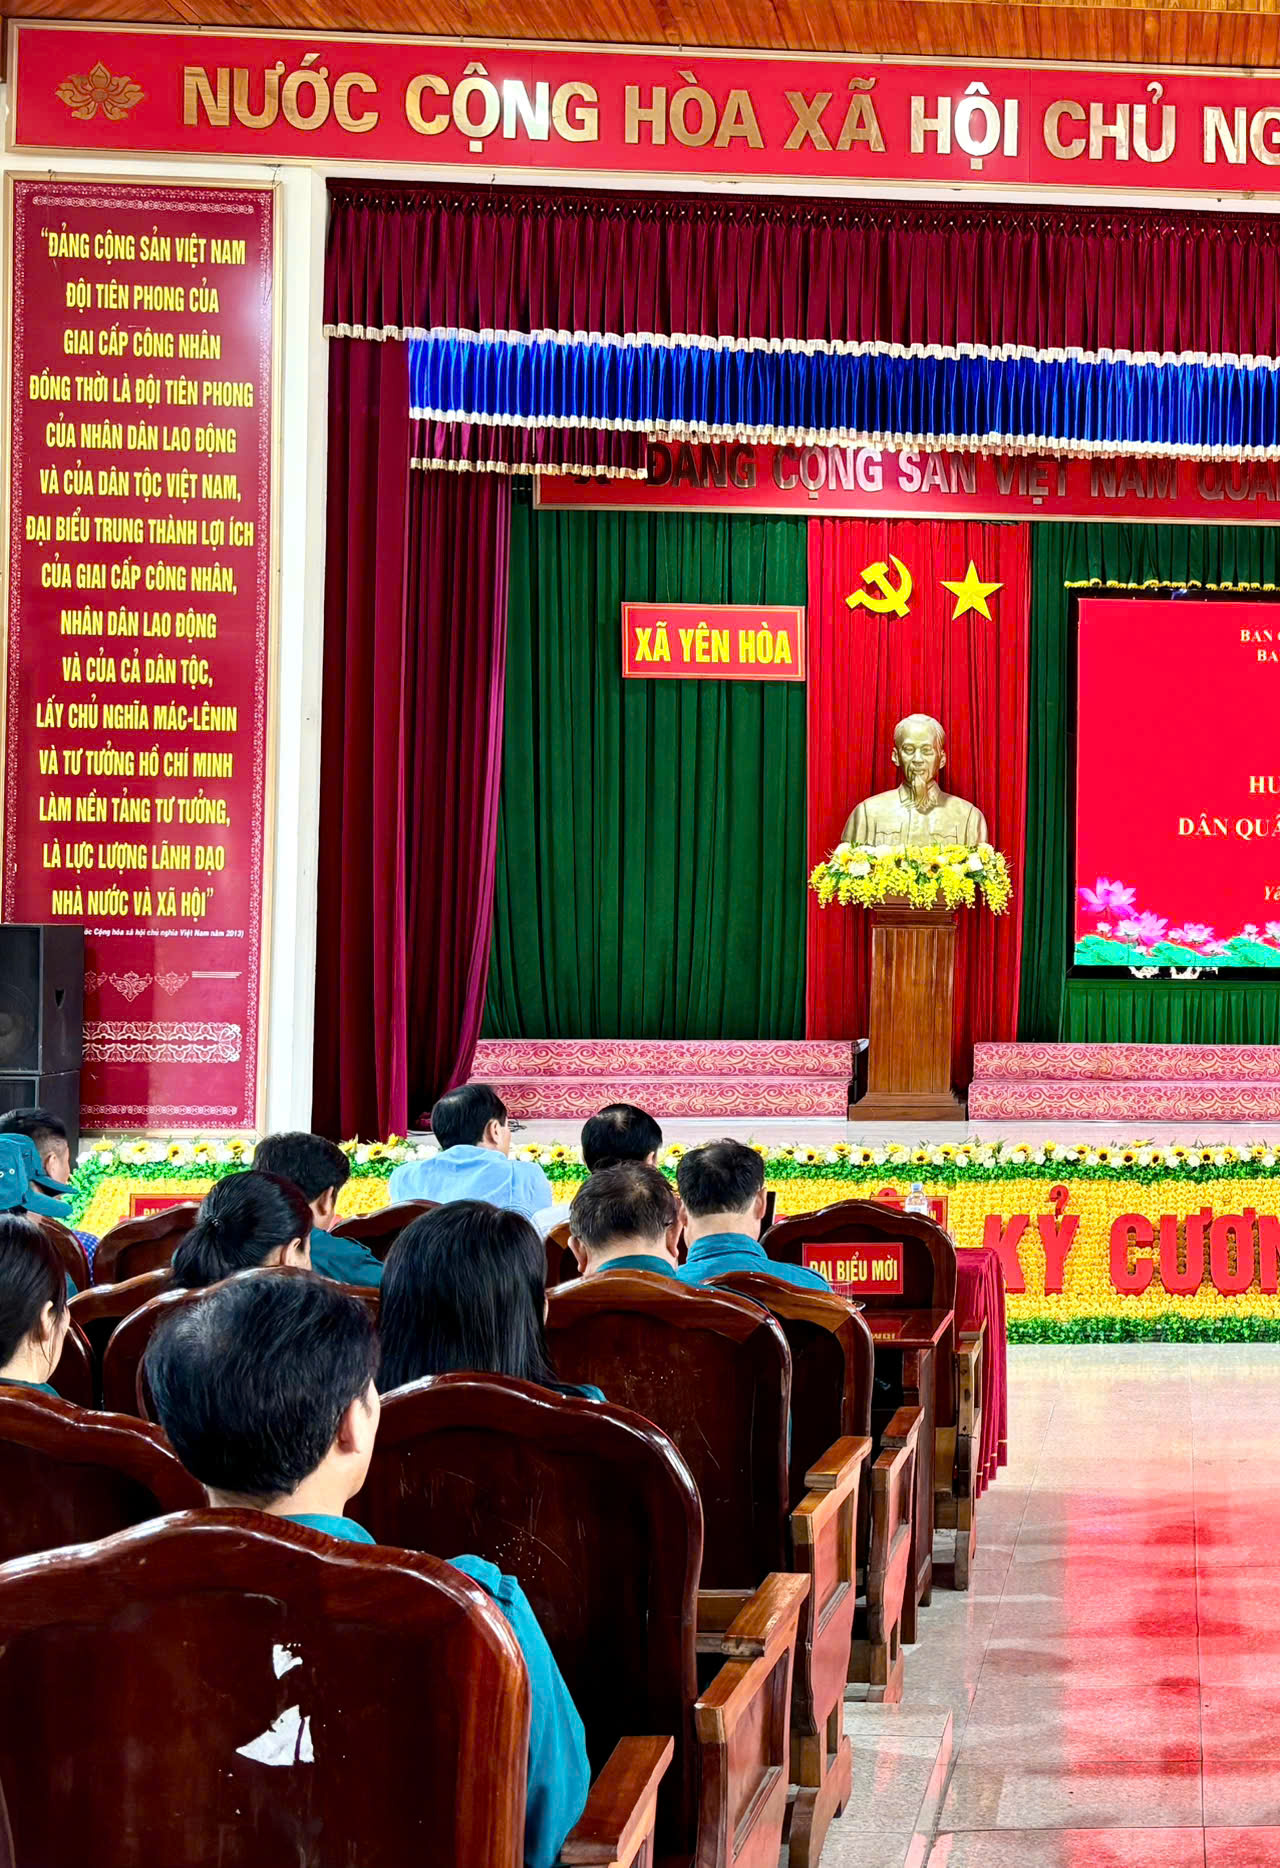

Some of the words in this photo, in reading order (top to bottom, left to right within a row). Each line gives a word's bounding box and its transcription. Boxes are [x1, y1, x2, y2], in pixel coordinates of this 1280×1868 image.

[183, 52, 379, 134] NƯỚC
[405, 61, 599, 153] CỘNG
[623, 70, 764, 149] HÒA
[783, 77, 886, 152] XÃ
[910, 80, 1019, 171] HỘI
[1043, 80, 1177, 163] CHỦ
[94, 229, 136, 265] CỘNG
[139, 225, 171, 262] SẢN
[174, 232, 207, 269] VIỆT
[210, 239, 246, 265] NAM
[65, 277, 92, 314] ĐỘI
[95, 278, 130, 310] TIÊN
[133, 285, 185, 312] PHONG
[188, 276, 220, 314] CỦA
[63, 329, 94, 355] GIAI
[98, 321, 129, 357] CẤP
[132, 327, 175, 358] CÔNG
[178, 328, 222, 361] NHÂN
[29, 366, 71, 401] ĐỒNG
[74, 370, 109, 403] THỜI
[112, 372, 132, 403] LÀ
[135, 373, 161, 410] ĐỘI
[164, 374, 199, 406] TIÊN
[202, 380, 254, 408] PHONG
[45, 411, 77, 449] CỦA
[80, 418, 123, 450] NHÂN
[127, 419, 159, 451] DÂN
[162, 426, 191, 452] LAO
[194, 422, 237, 458] ĐỘNG
[39, 463, 60, 495] VÀ
[63, 459, 95, 496] CỦA
[97, 465, 130, 497] DÂN
[133, 466, 163, 503] TỘC
[165, 467, 199, 504] VIỆT
[201, 473, 242, 503] NAM,
[25, 515, 51, 547] ĐẠI
[55, 506, 90, 543] BIỂU
[93, 517, 144, 544] TRUNG
[147, 513, 198, 545] THÀNH
[201, 518, 225, 552] LỢI
[228, 515, 254, 547] ÍCH
[634, 620, 672, 663] XÃ
[678, 621, 731, 664] YÊN
[738, 621, 793, 665] HÒA
[1240, 629, 1273, 643] BAN
[1178, 812, 1229, 837] DÂN
[984, 1184, 1081, 1295] KỶ
[836, 1250, 868, 1282] BIỂU
[871, 1253, 899, 1282] MỜI
